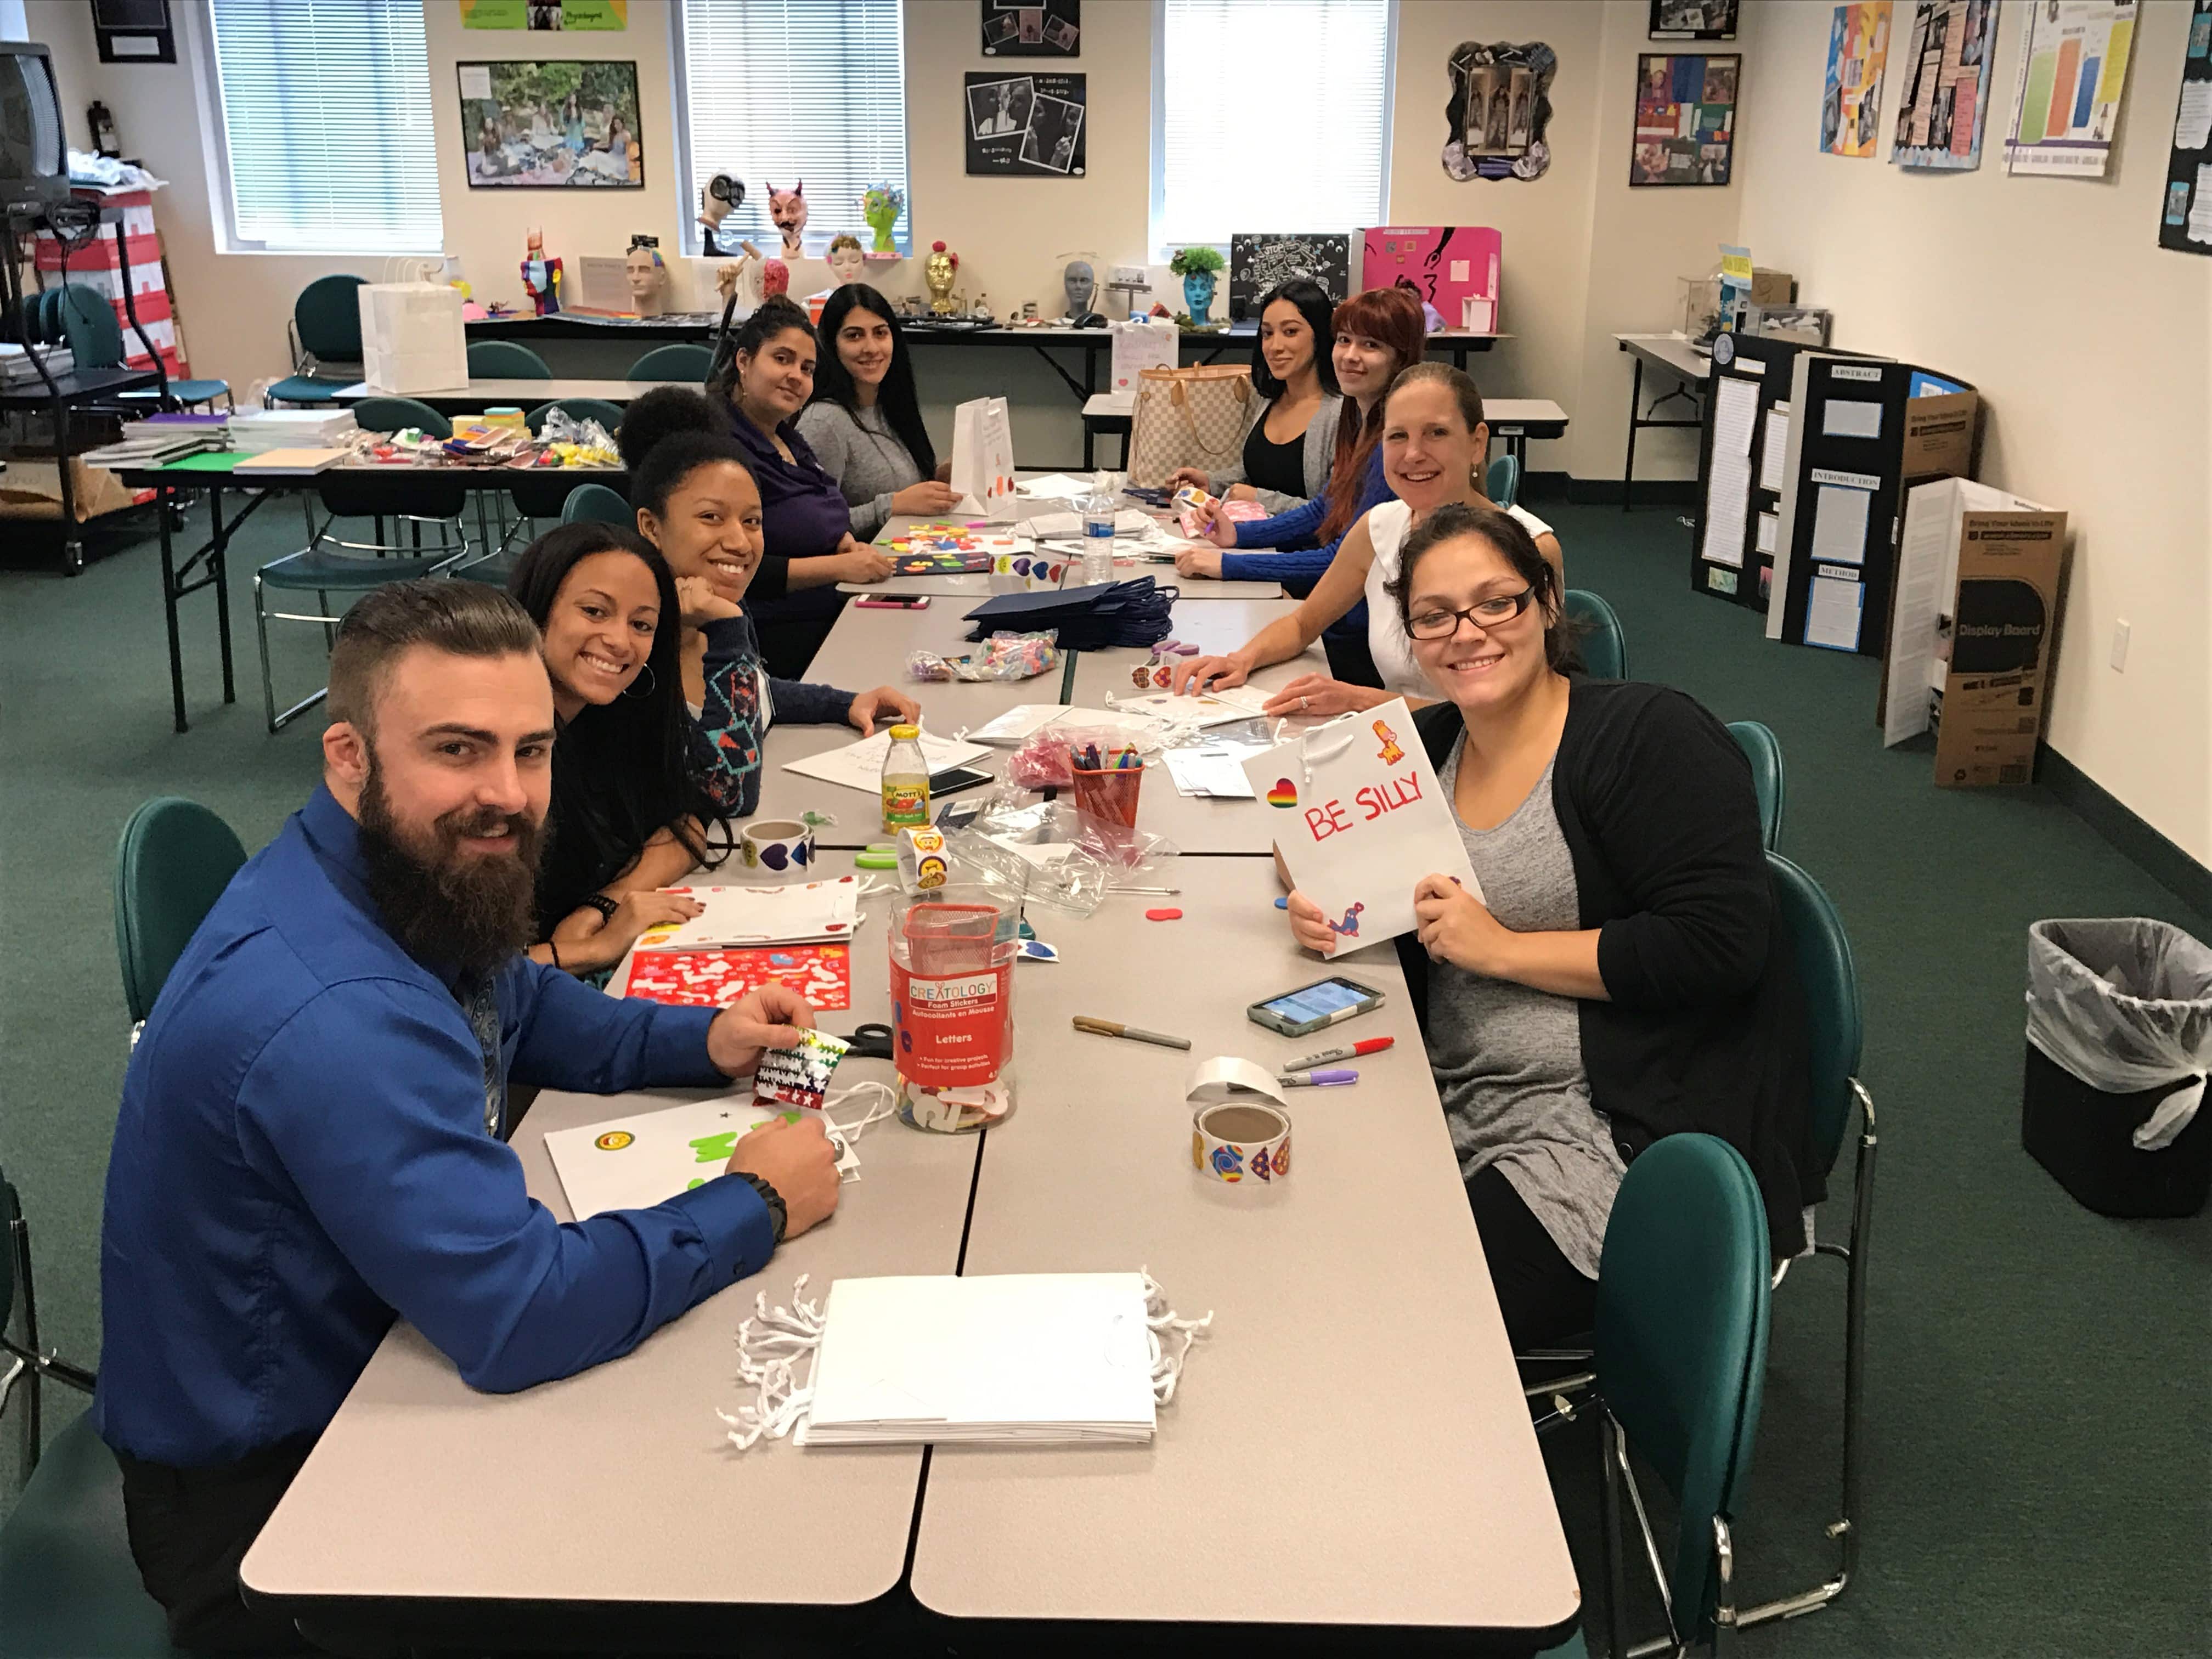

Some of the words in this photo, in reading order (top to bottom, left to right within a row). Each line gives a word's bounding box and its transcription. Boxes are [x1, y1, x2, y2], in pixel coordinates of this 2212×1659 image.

[1835, 369, 1880, 378] ABSTRACT
[1814, 472, 1878, 486] INTRODUCTION
[1821, 567, 1857, 578] METHOD
[1960, 624, 2002, 638] Display
[2004, 623, 2041, 636] Board
[1305, 799, 1354, 842] BE
[1356, 771, 1423, 821] SILLY
[911, 982, 993, 1000] CREATOLOGY
[950, 998, 978, 1008] Stickers
[912, 1009, 956, 1019] Autocollants
[968, 1006, 995, 1015] Mousse
[936, 1034, 973, 1044] Letters
[967, 1054, 988, 1063] projects
[968, 1060, 990, 1069] activities
